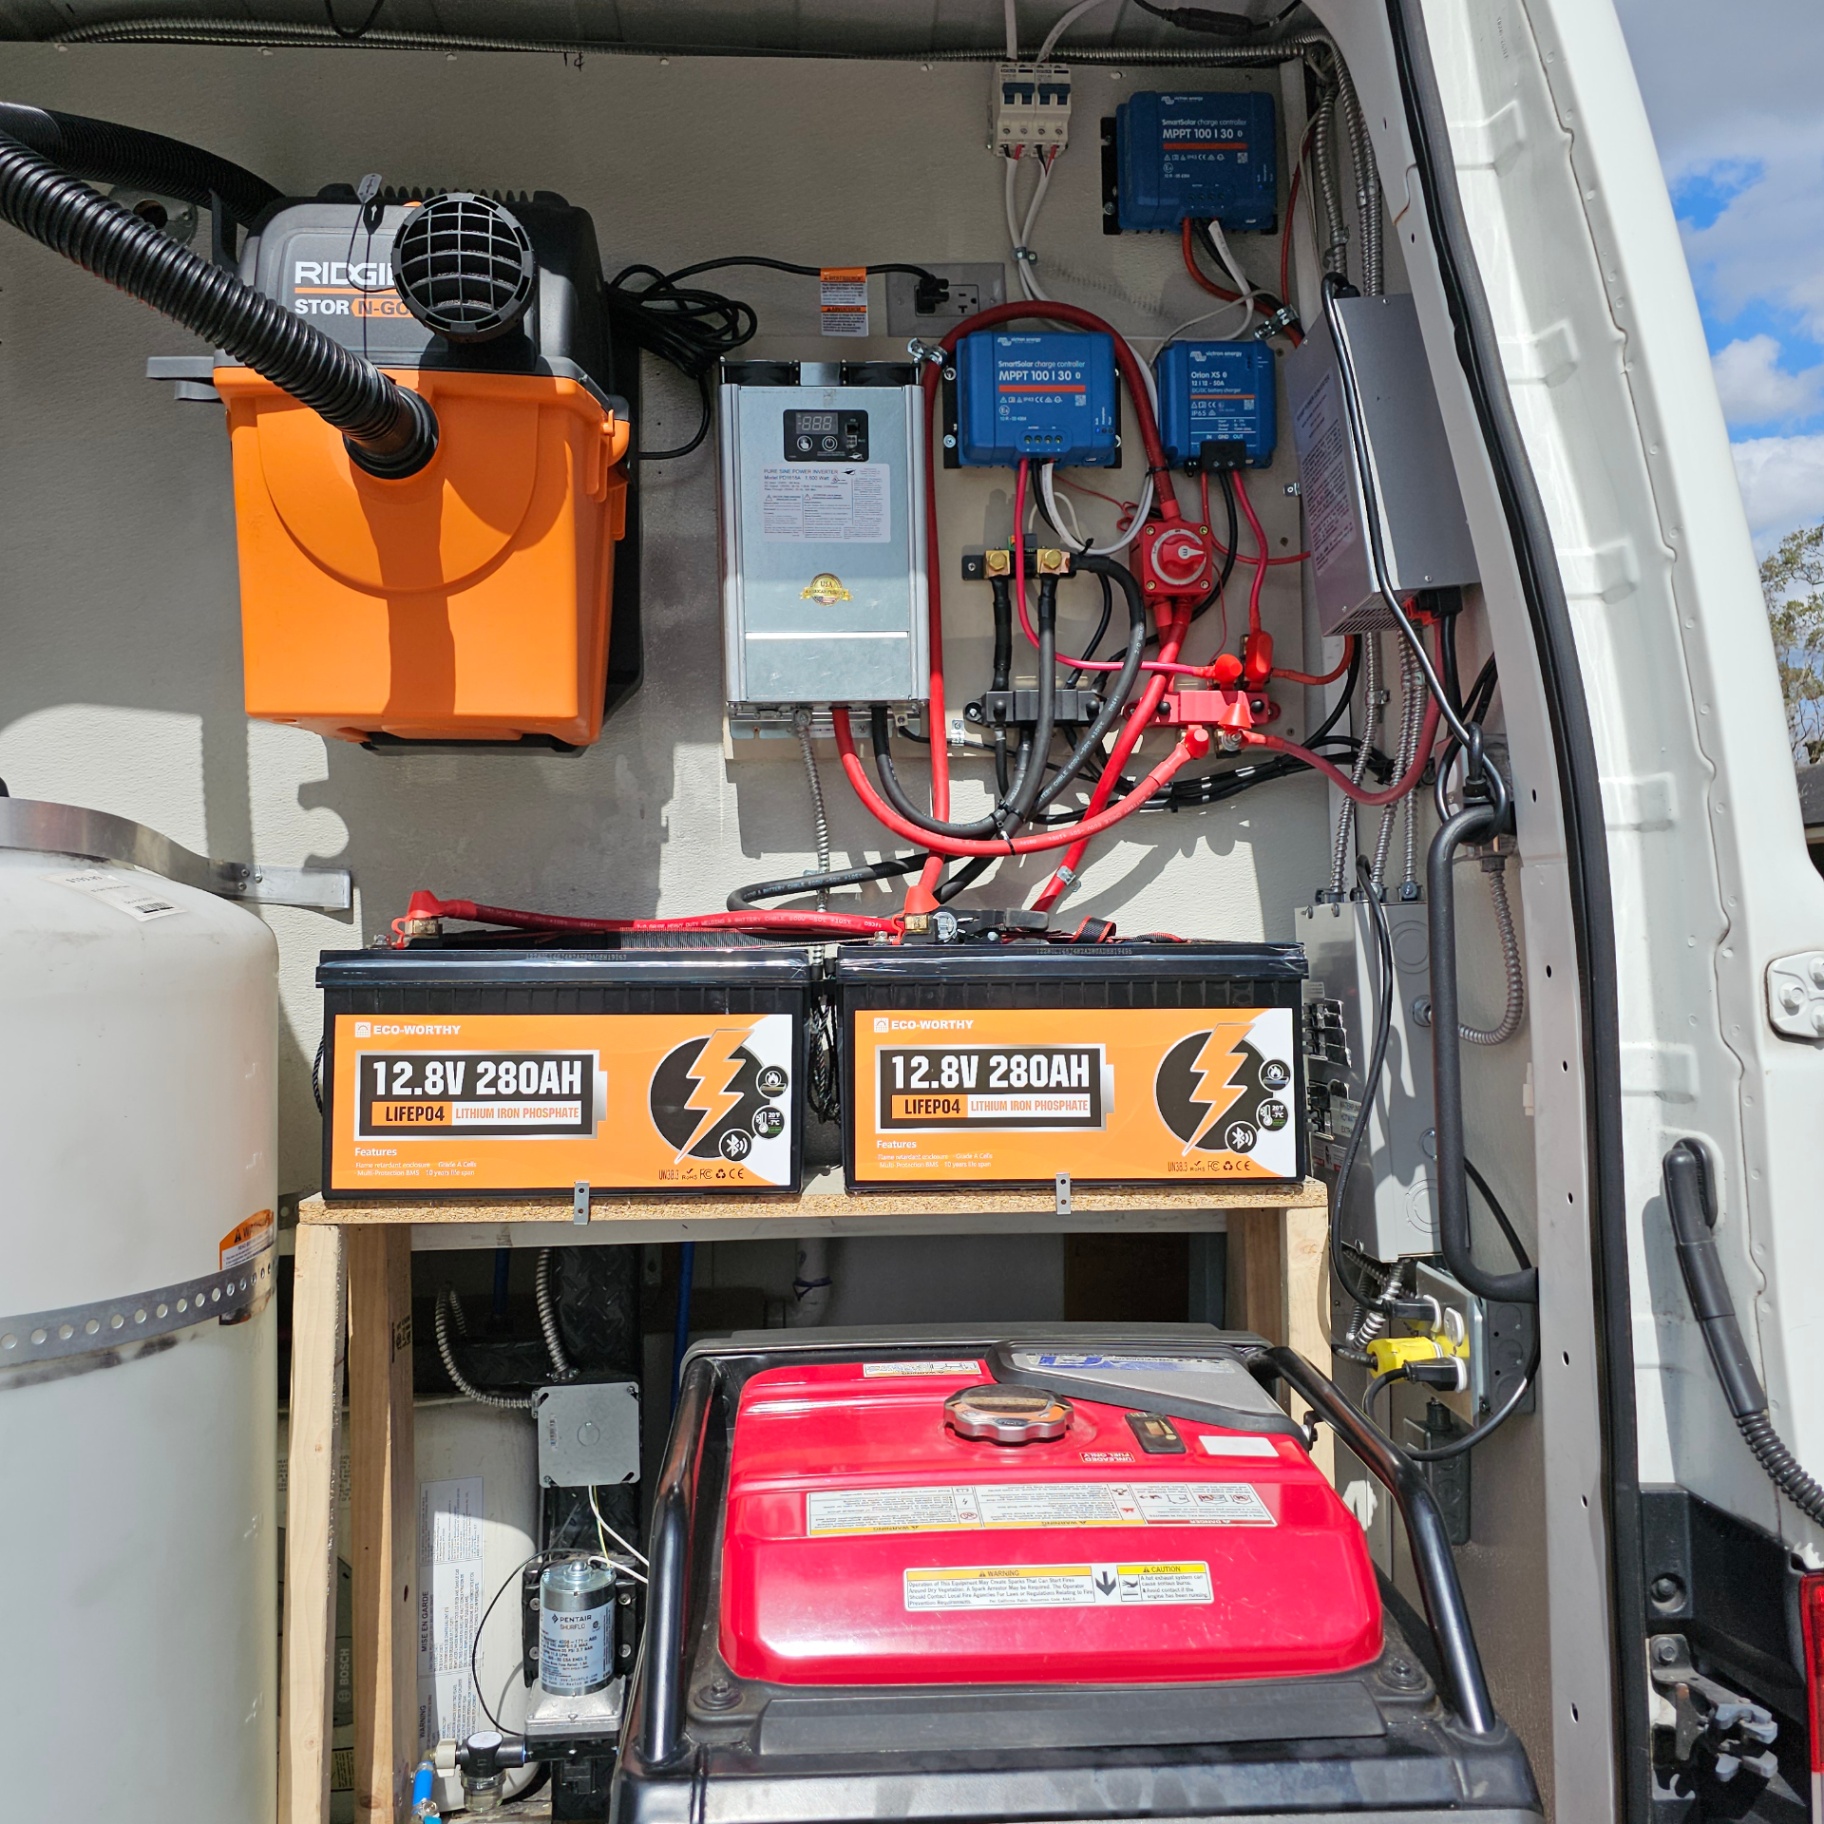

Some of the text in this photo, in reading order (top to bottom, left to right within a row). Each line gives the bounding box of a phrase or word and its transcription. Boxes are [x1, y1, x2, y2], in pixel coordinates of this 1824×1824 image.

[1163, 129, 1233, 138] MPPT 100 30
[294, 299, 350, 315] STOR
[1034, 361, 1056, 369] charge
[999, 371, 1071, 380] MPPT 100 30
[891, 1019, 974, 1030] ECO-WORTHY
[373, 1025, 461, 1035] ECO-WORTHY
[892, 1054, 1090, 1089] 12.8V 280AH
[373, 1060, 582, 1096] 12.8V 280AH
[904, 1099, 1088, 1114] LIFEPO4 LITHIUM IRON PHOSPHATE
[385, 1106, 579, 1122] LIFEPO4 LITHIUM IRON PHOSPHATE
[876, 1140, 917, 1148] Features
[355, 1147, 397, 1156] Features
[434, 1170, 449, 1178] years
[461, 1170, 475, 1178] span
[421, 1591, 429, 1652] MISE EN GARDE
[560, 1615, 592, 1623] PENTAIR
[340, 1648, 349, 1685] BOSCH
